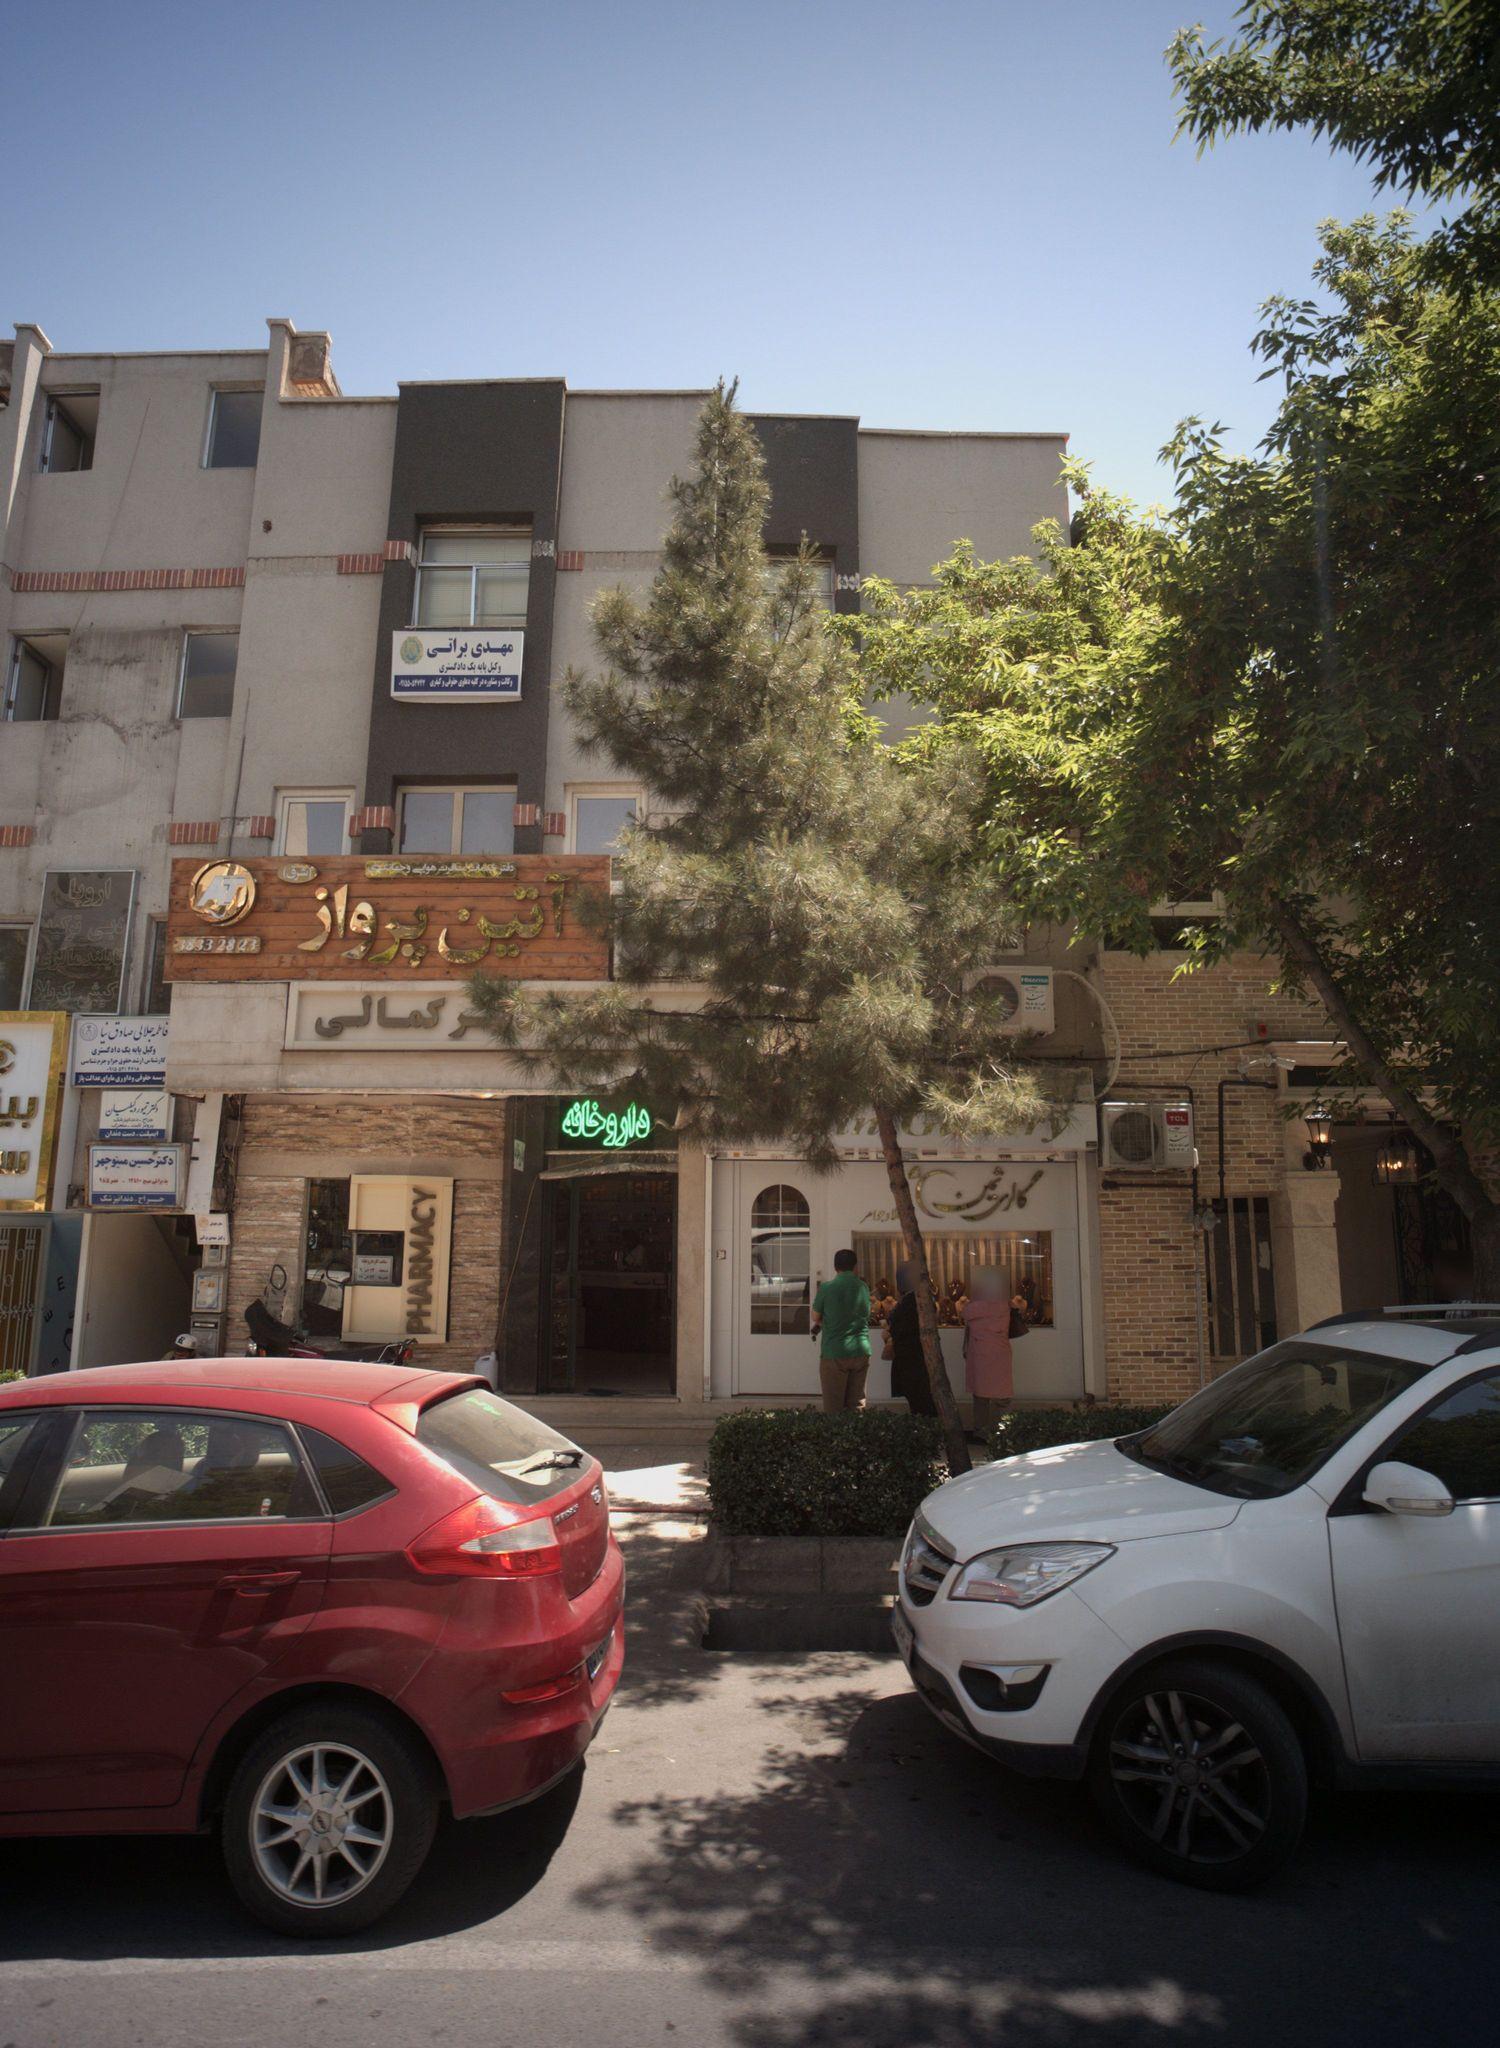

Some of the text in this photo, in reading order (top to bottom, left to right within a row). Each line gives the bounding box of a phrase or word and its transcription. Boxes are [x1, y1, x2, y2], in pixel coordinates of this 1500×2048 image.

[427, 637, 513, 659] مهدی براتی
[439, 662, 502, 674] وکیل پایه یک دادگستری
[297, 883, 429, 969] پرواز
[315, 994, 446, 1038] کمالی
[91, 1046, 120, 1056] دادگستری
[143, 1046, 156, 1055] وکیل
[147, 1095, 165, 1115] دکتر
[562, 1099, 651, 1147] داروخانه
[129, 1158, 156, 1168] حسین
[153, 1155, 174, 1168] دکتر
[138, 1195, 165, 1204] جراح
[407, 1187, 437, 1336] PHARMACY
